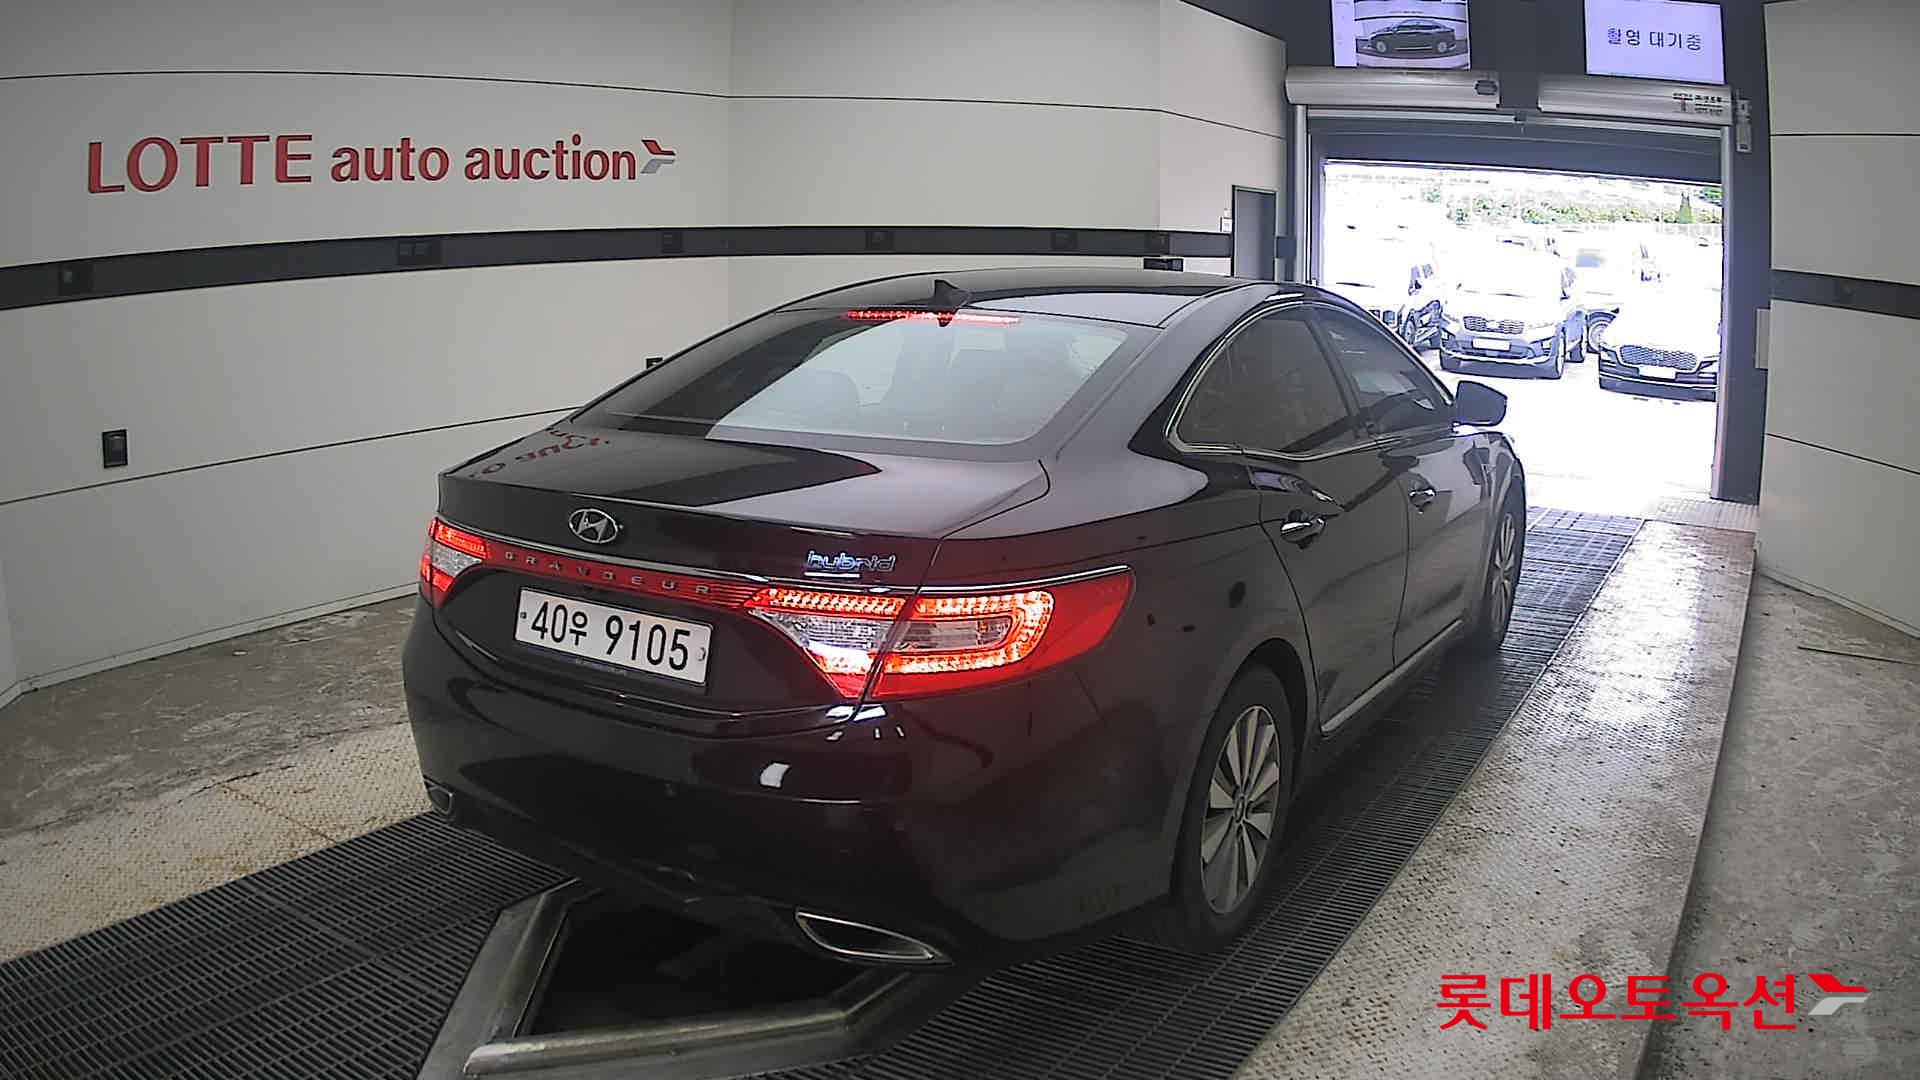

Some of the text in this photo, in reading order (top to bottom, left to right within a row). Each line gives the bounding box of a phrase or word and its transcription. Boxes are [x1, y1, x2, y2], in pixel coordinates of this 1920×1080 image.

[88, 134, 637, 194] LOTTE auto auction
[807, 550, 896, 572] hybrid
[530, 600, 692, 671] 40우 9105
